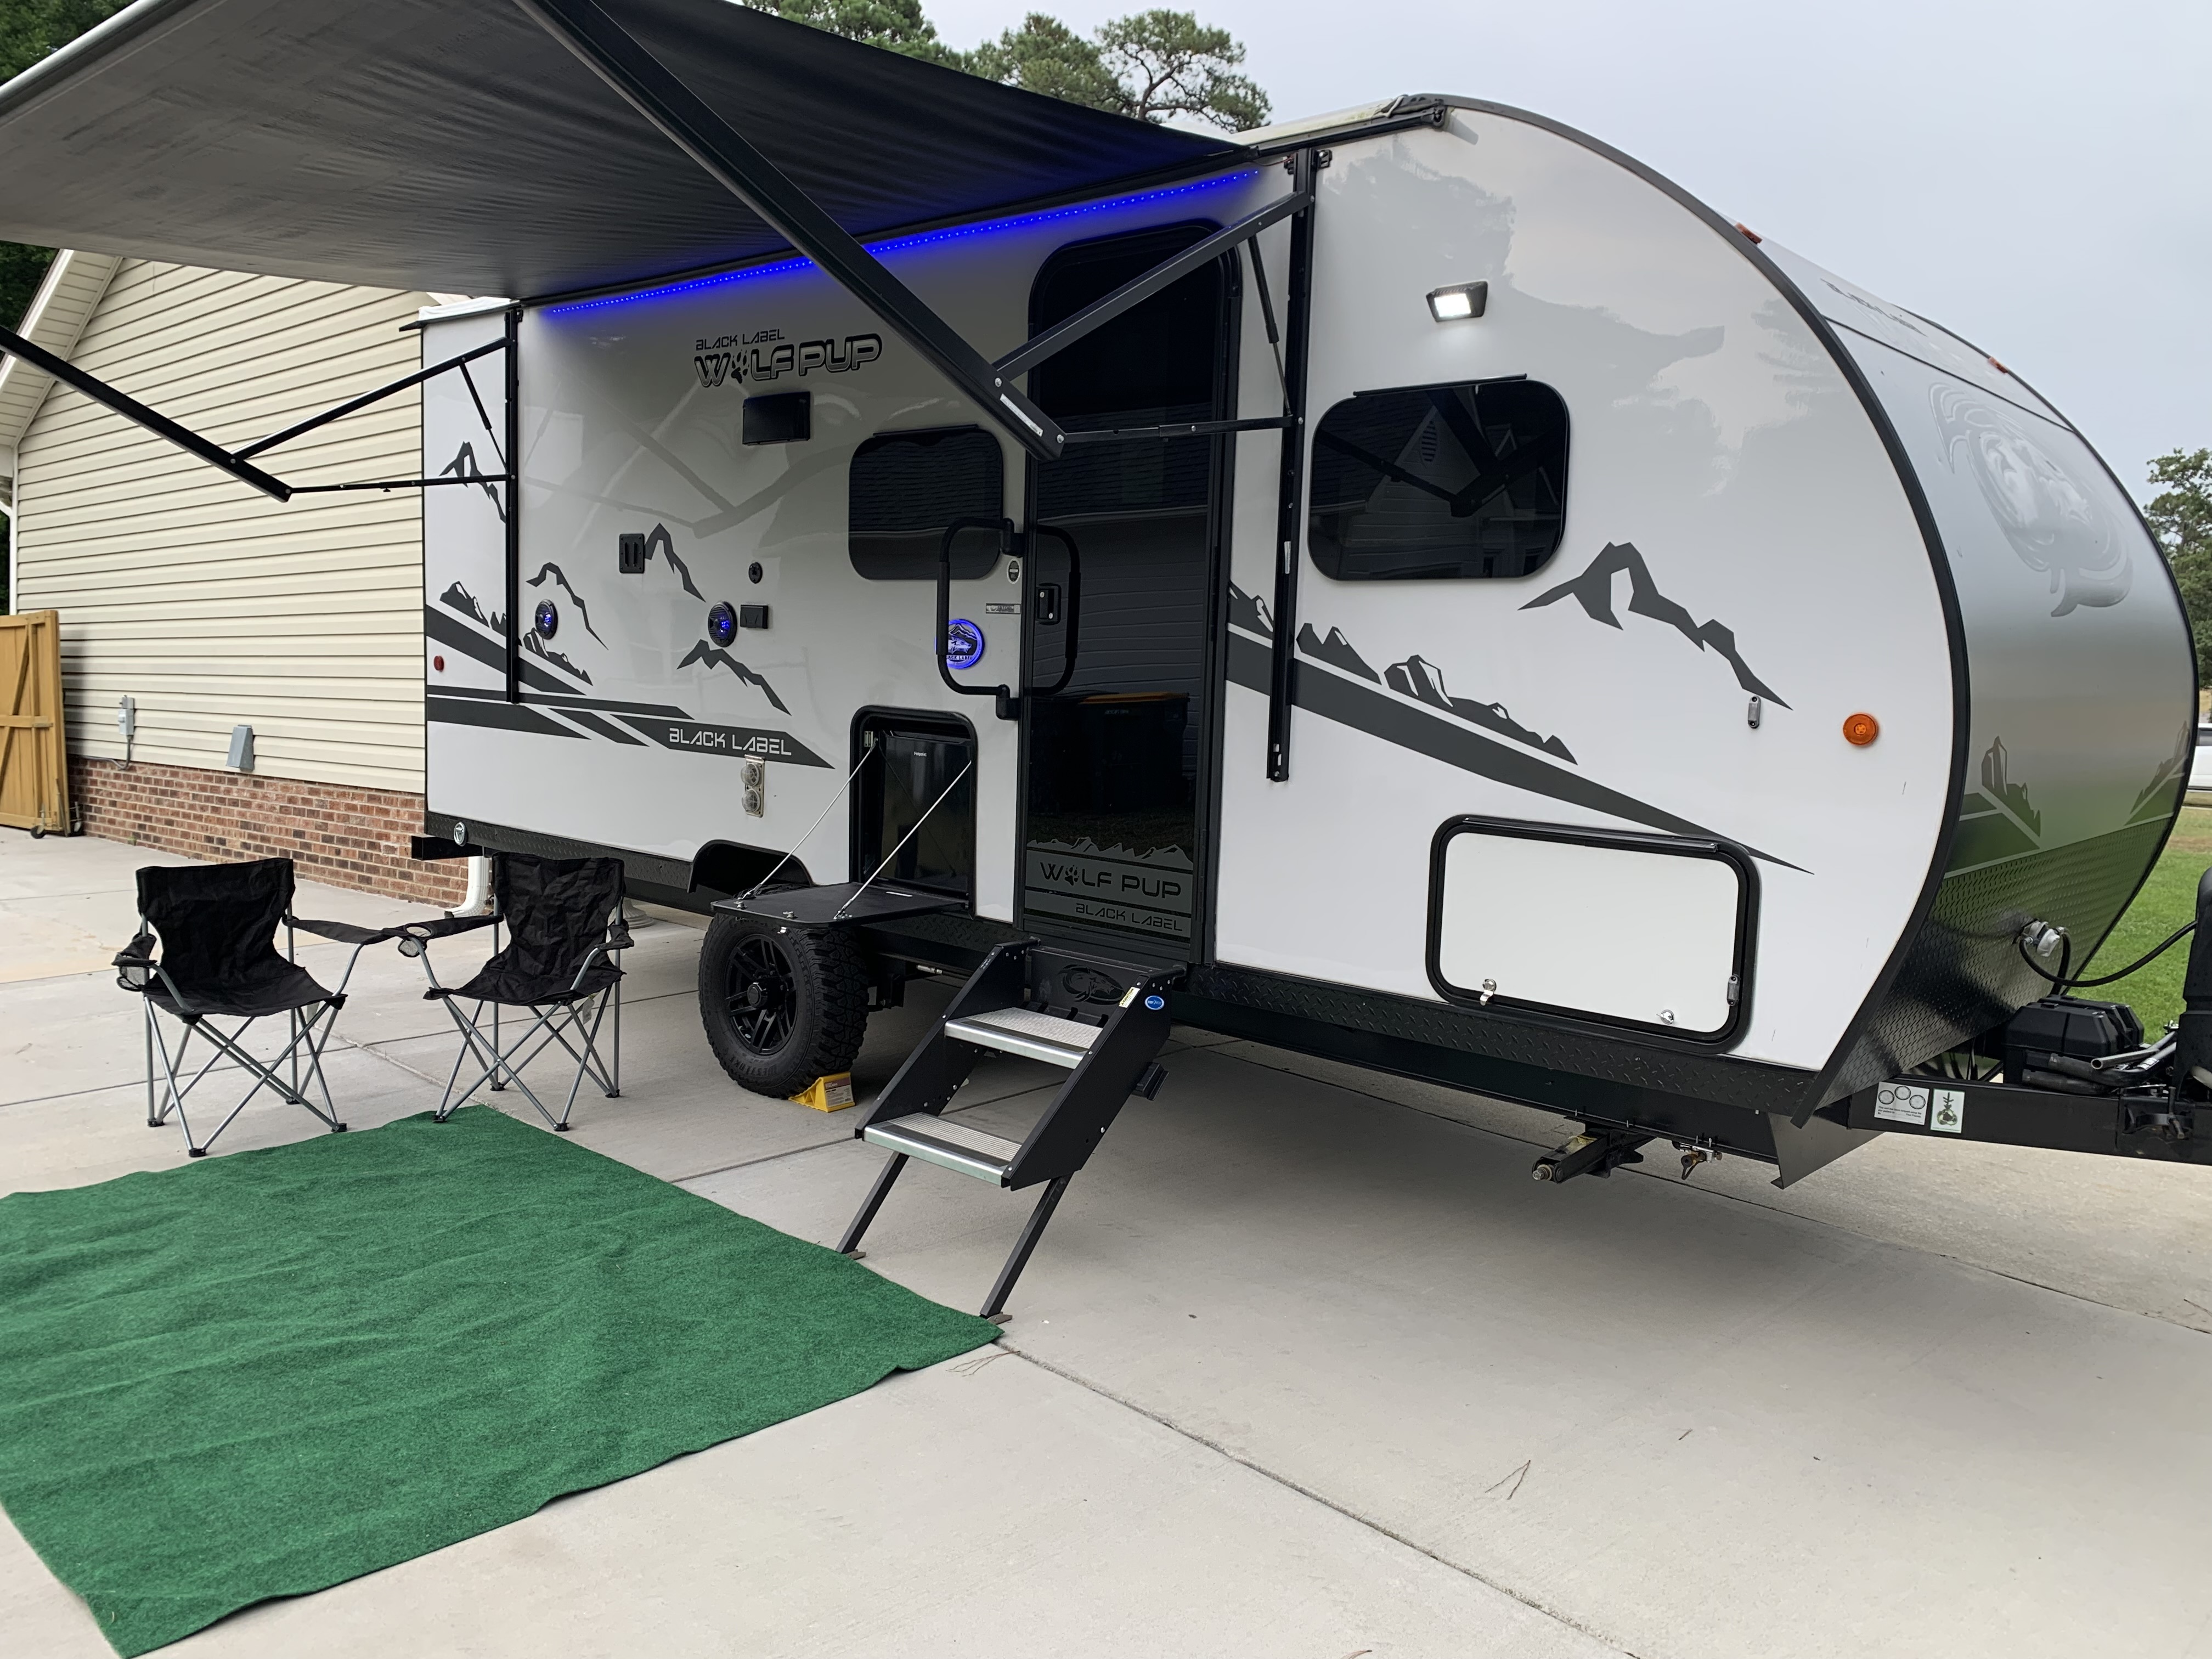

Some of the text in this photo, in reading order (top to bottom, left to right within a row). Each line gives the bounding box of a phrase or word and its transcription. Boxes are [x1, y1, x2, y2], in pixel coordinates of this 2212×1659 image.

[696, 329, 785, 351] BLACK LABEL
[798, 333, 883, 377] PUP
[669, 727, 792, 756] BLACK LABEL
[1121, 874, 1181, 899] PUP
[1076, 902, 1183, 932] BLACK LABEL
